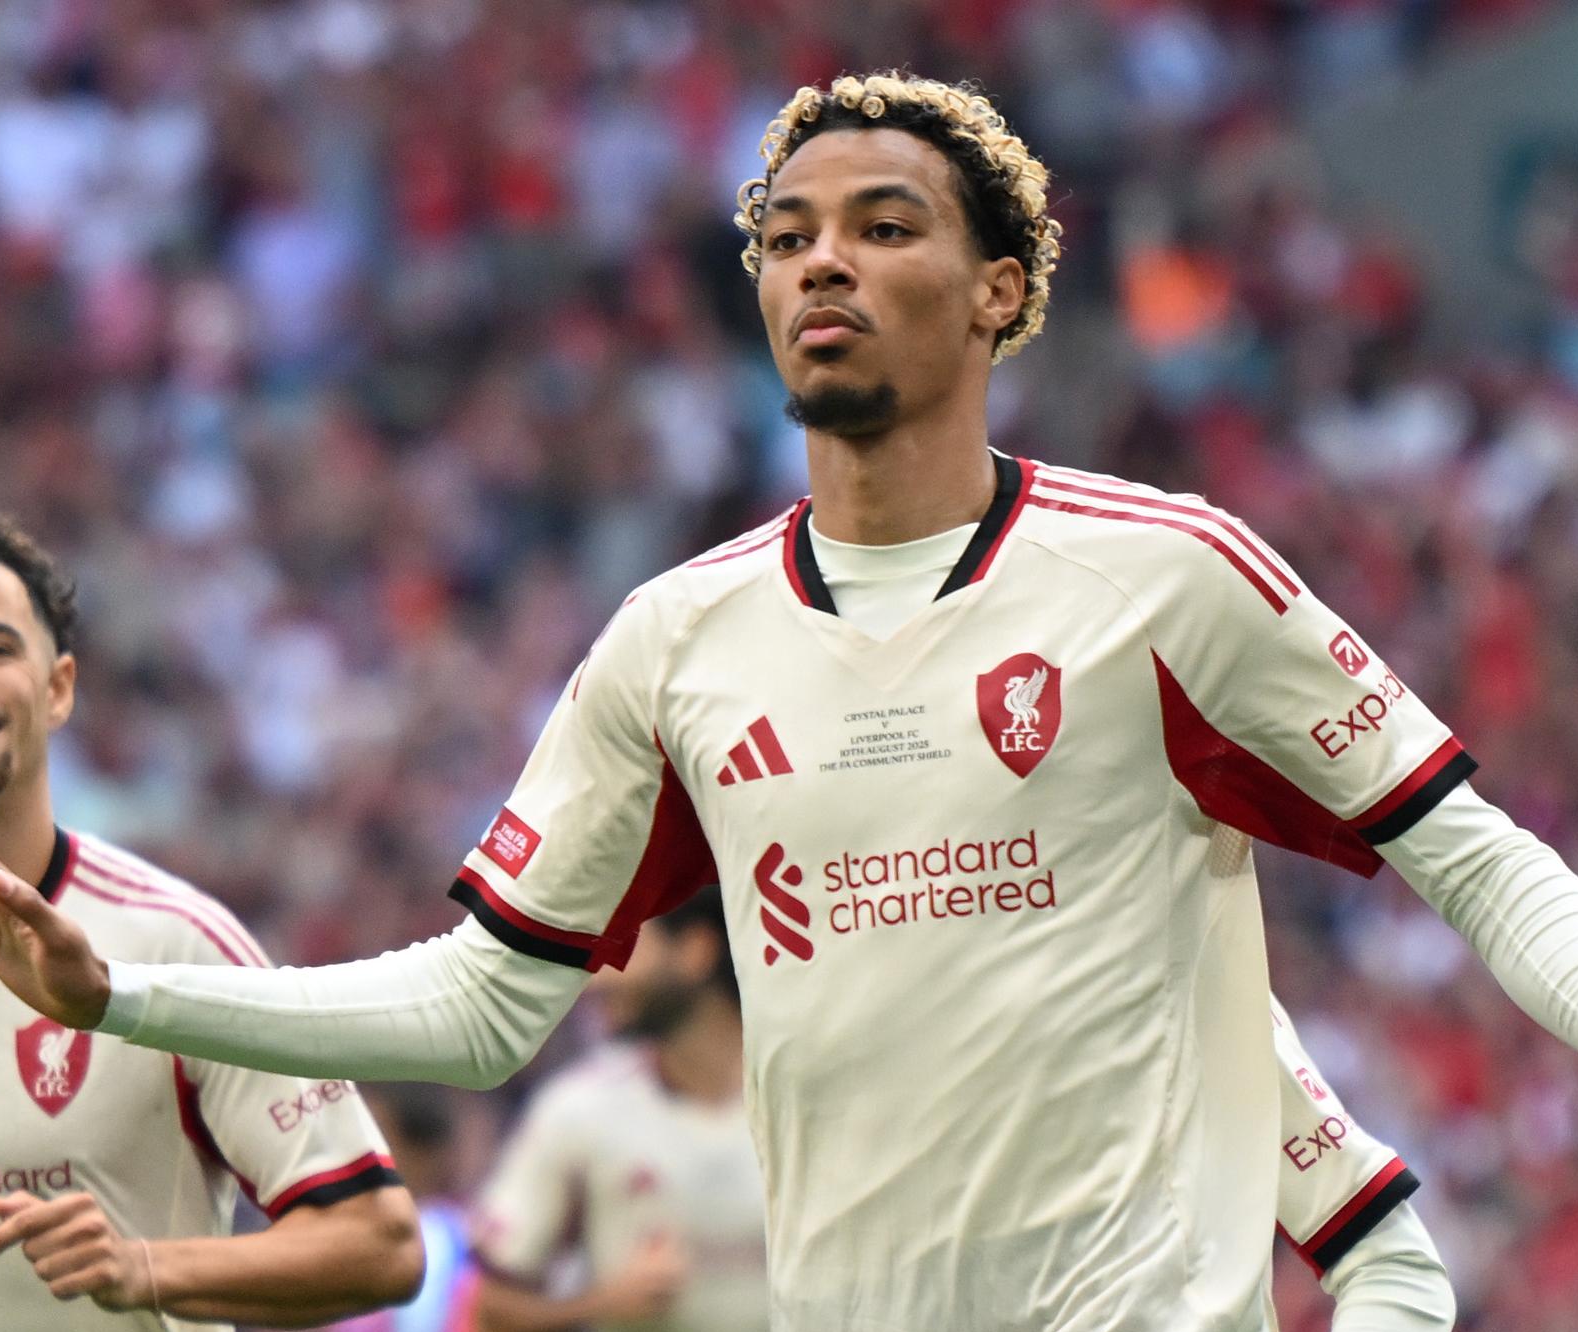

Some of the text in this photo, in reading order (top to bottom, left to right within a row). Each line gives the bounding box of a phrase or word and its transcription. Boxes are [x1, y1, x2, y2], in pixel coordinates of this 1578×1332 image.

[844, 705, 925, 722] CRYSTAL PALACE
[850, 729, 919, 745] LIVERPOOL FC
[866, 743, 905, 755] AUGUST
[907, 739, 929, 751] 2025
[819, 748, 952, 772] THE FA COMMUNITY SHIELD
[823, 828, 1039, 893] standard
[829, 870, 1057, 934] chartered
